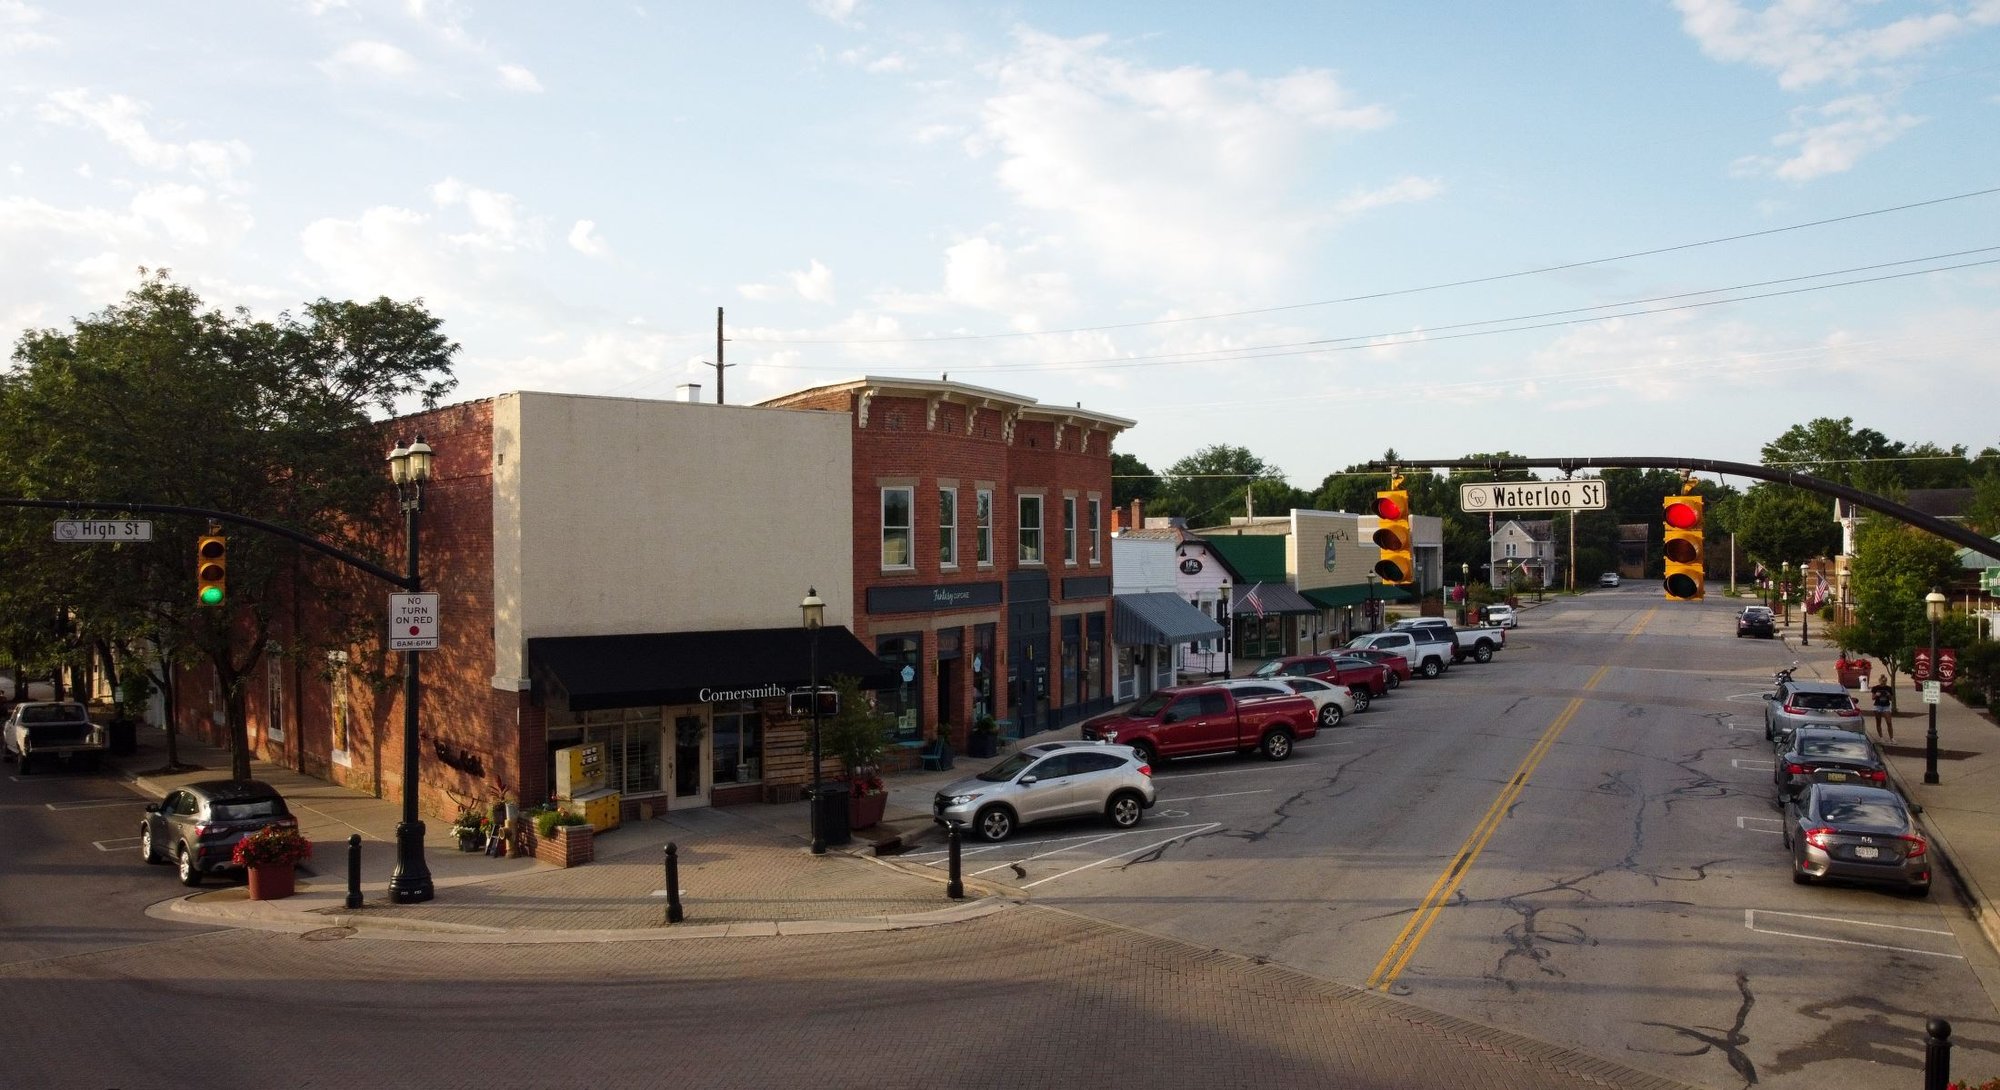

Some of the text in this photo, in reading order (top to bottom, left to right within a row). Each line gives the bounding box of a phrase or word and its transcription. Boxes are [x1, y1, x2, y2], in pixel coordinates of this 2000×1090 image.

[1493, 486, 1571, 507] Waterloo
[1582, 485, 1599, 505] St
[82, 522, 116, 539] High
[124, 522, 139, 535] St
[407, 597, 422, 605] NO
[401, 607, 428, 615] TURN
[395, 616, 433, 624] ON RED
[699, 683, 786, 703] Cornersmiths
